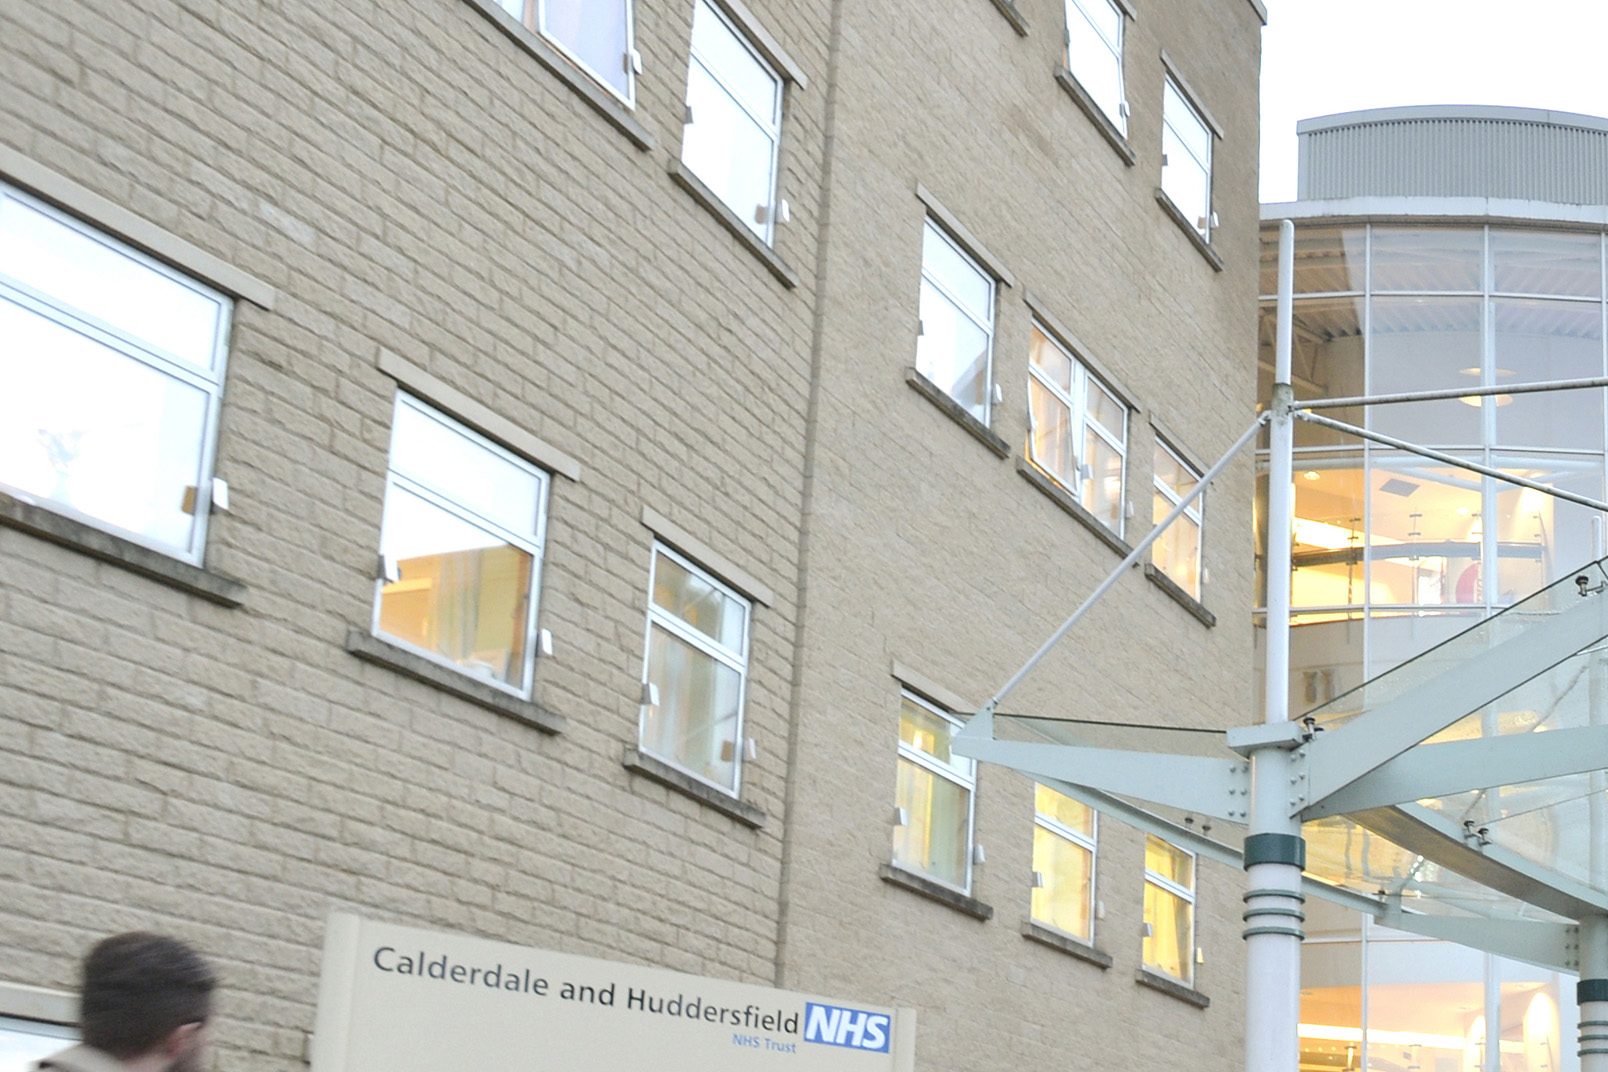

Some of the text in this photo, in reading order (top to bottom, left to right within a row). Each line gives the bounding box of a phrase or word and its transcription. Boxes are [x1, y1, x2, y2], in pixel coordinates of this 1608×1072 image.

[373, 946, 890, 1050] Calderdale and Huddersfield NHS
[732, 1033, 797, 1054] NHS Trust
